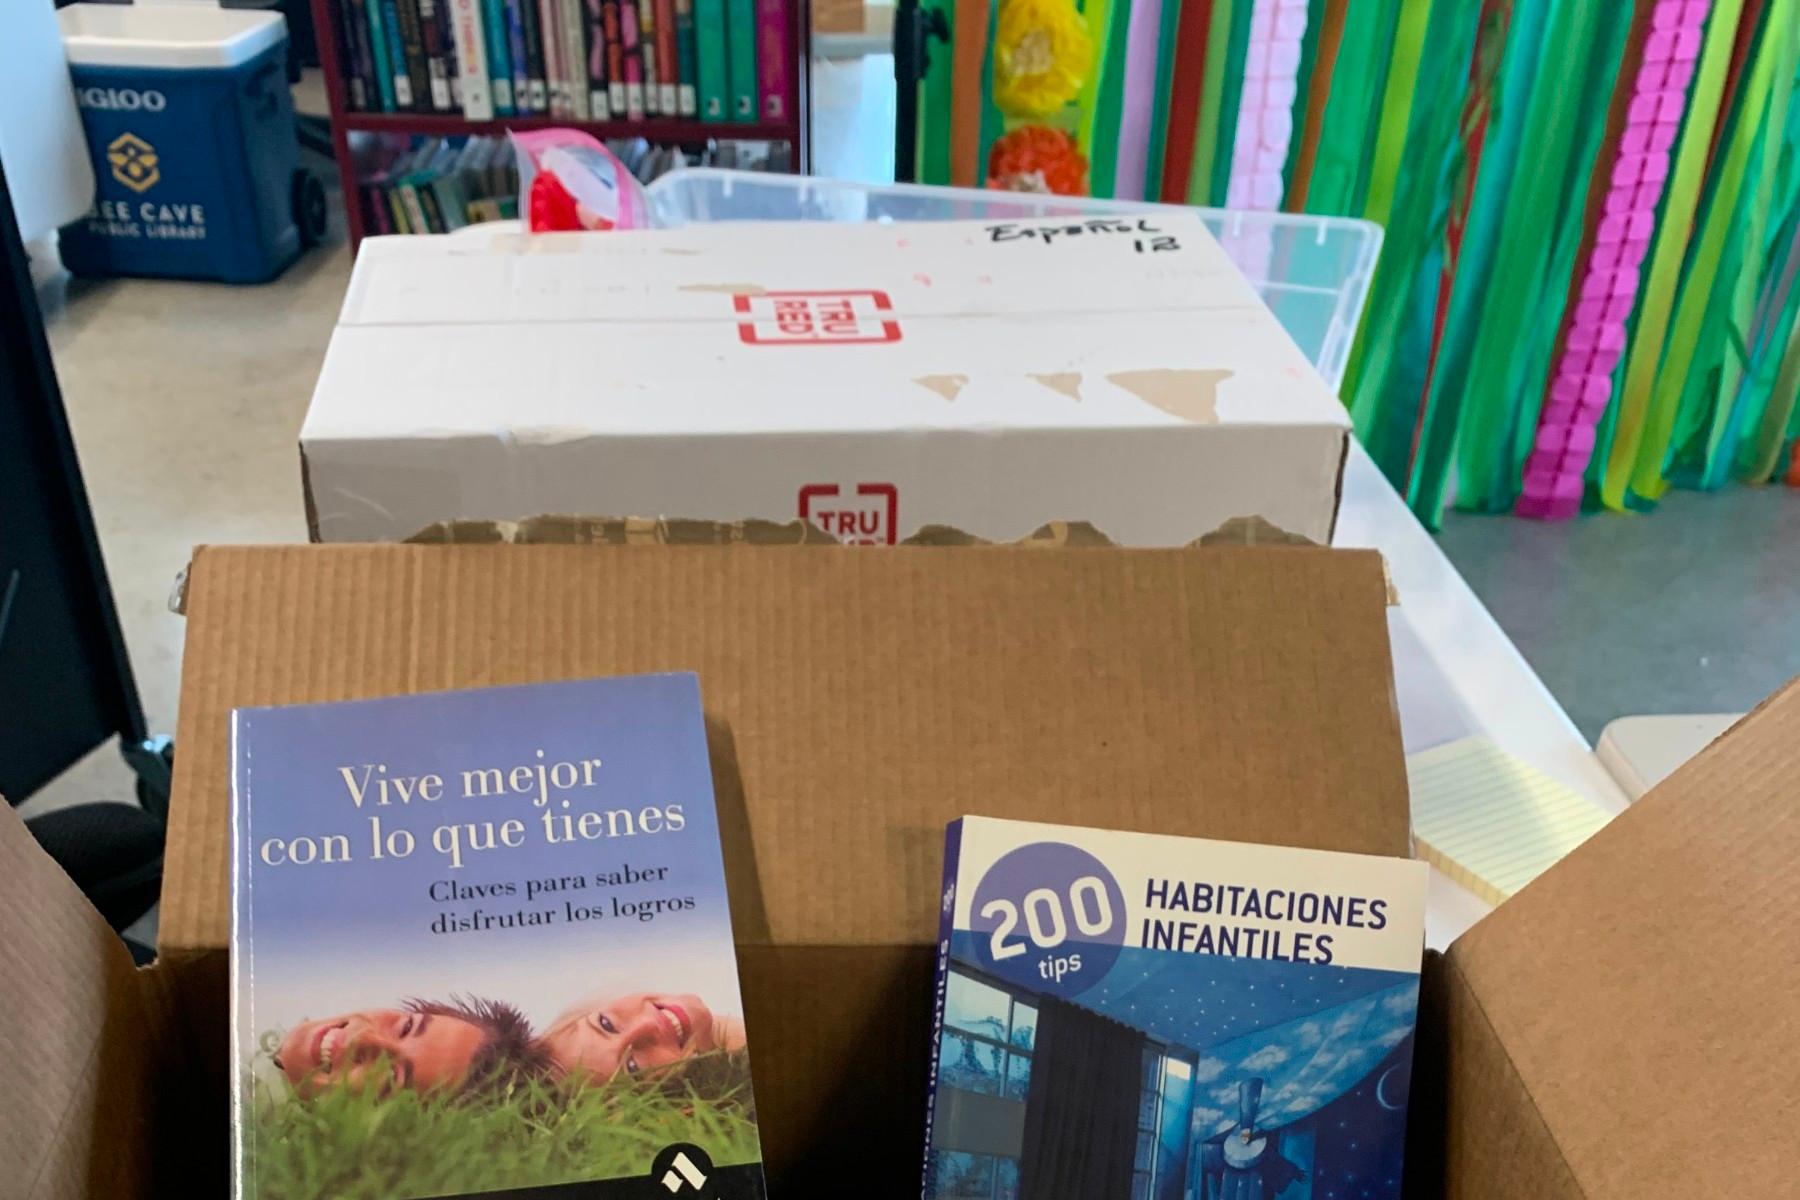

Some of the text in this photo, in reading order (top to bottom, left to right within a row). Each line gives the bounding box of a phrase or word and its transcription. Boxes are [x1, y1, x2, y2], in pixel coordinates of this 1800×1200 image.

[140, 202, 205, 224] CAVE
[817, 510, 879, 535] TRU
[338, 749, 602, 809] Vive mejor
[260, 800, 687, 870] con lo que tienes
[429, 863, 669, 902] Claves para saber
[1145, 878, 1388, 930] HABITACIONES
[430, 895, 696, 935] disfrutar los logros
[981, 875, 1113, 962] 200
[1141, 918, 1335, 966] INFANTILES
[1037, 951, 1083, 984] tips
